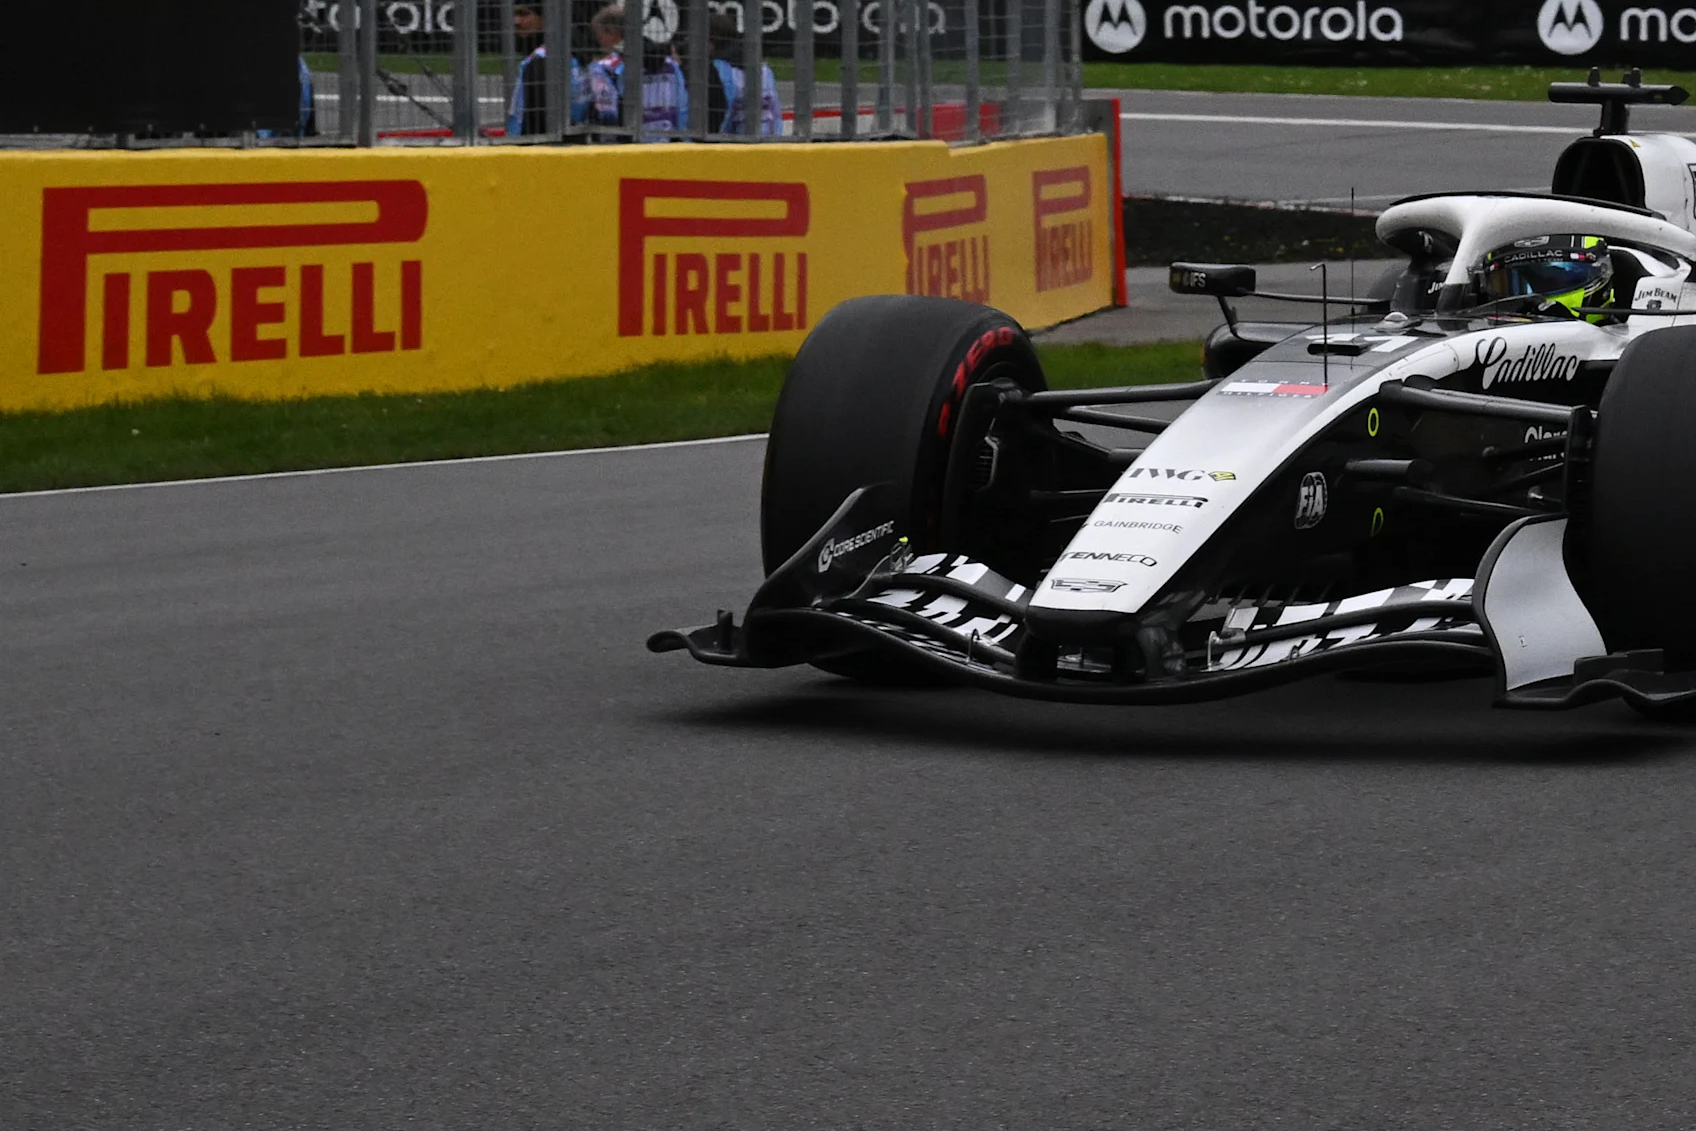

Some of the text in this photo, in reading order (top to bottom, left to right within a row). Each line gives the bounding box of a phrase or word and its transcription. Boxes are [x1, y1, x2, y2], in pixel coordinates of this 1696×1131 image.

[1164, 0, 1403, 42] motorola
[618, 177, 811, 337] PIRELLI
[902, 173, 989, 304] PIRELLI
[1503, 249, 1564, 264] CADILLAC
[37, 179, 429, 375] PIRELLI
[1634, 287, 1678, 304] JIM BEAM
[1474, 336, 1581, 391] Cadillac
[1102, 492, 1209, 508] PIRELLI
[1297, 482, 1324, 519] FIA
[1093, 519, 1184, 535] GAINBRIDGE
[1059, 550, 1158, 568] TENNECO
